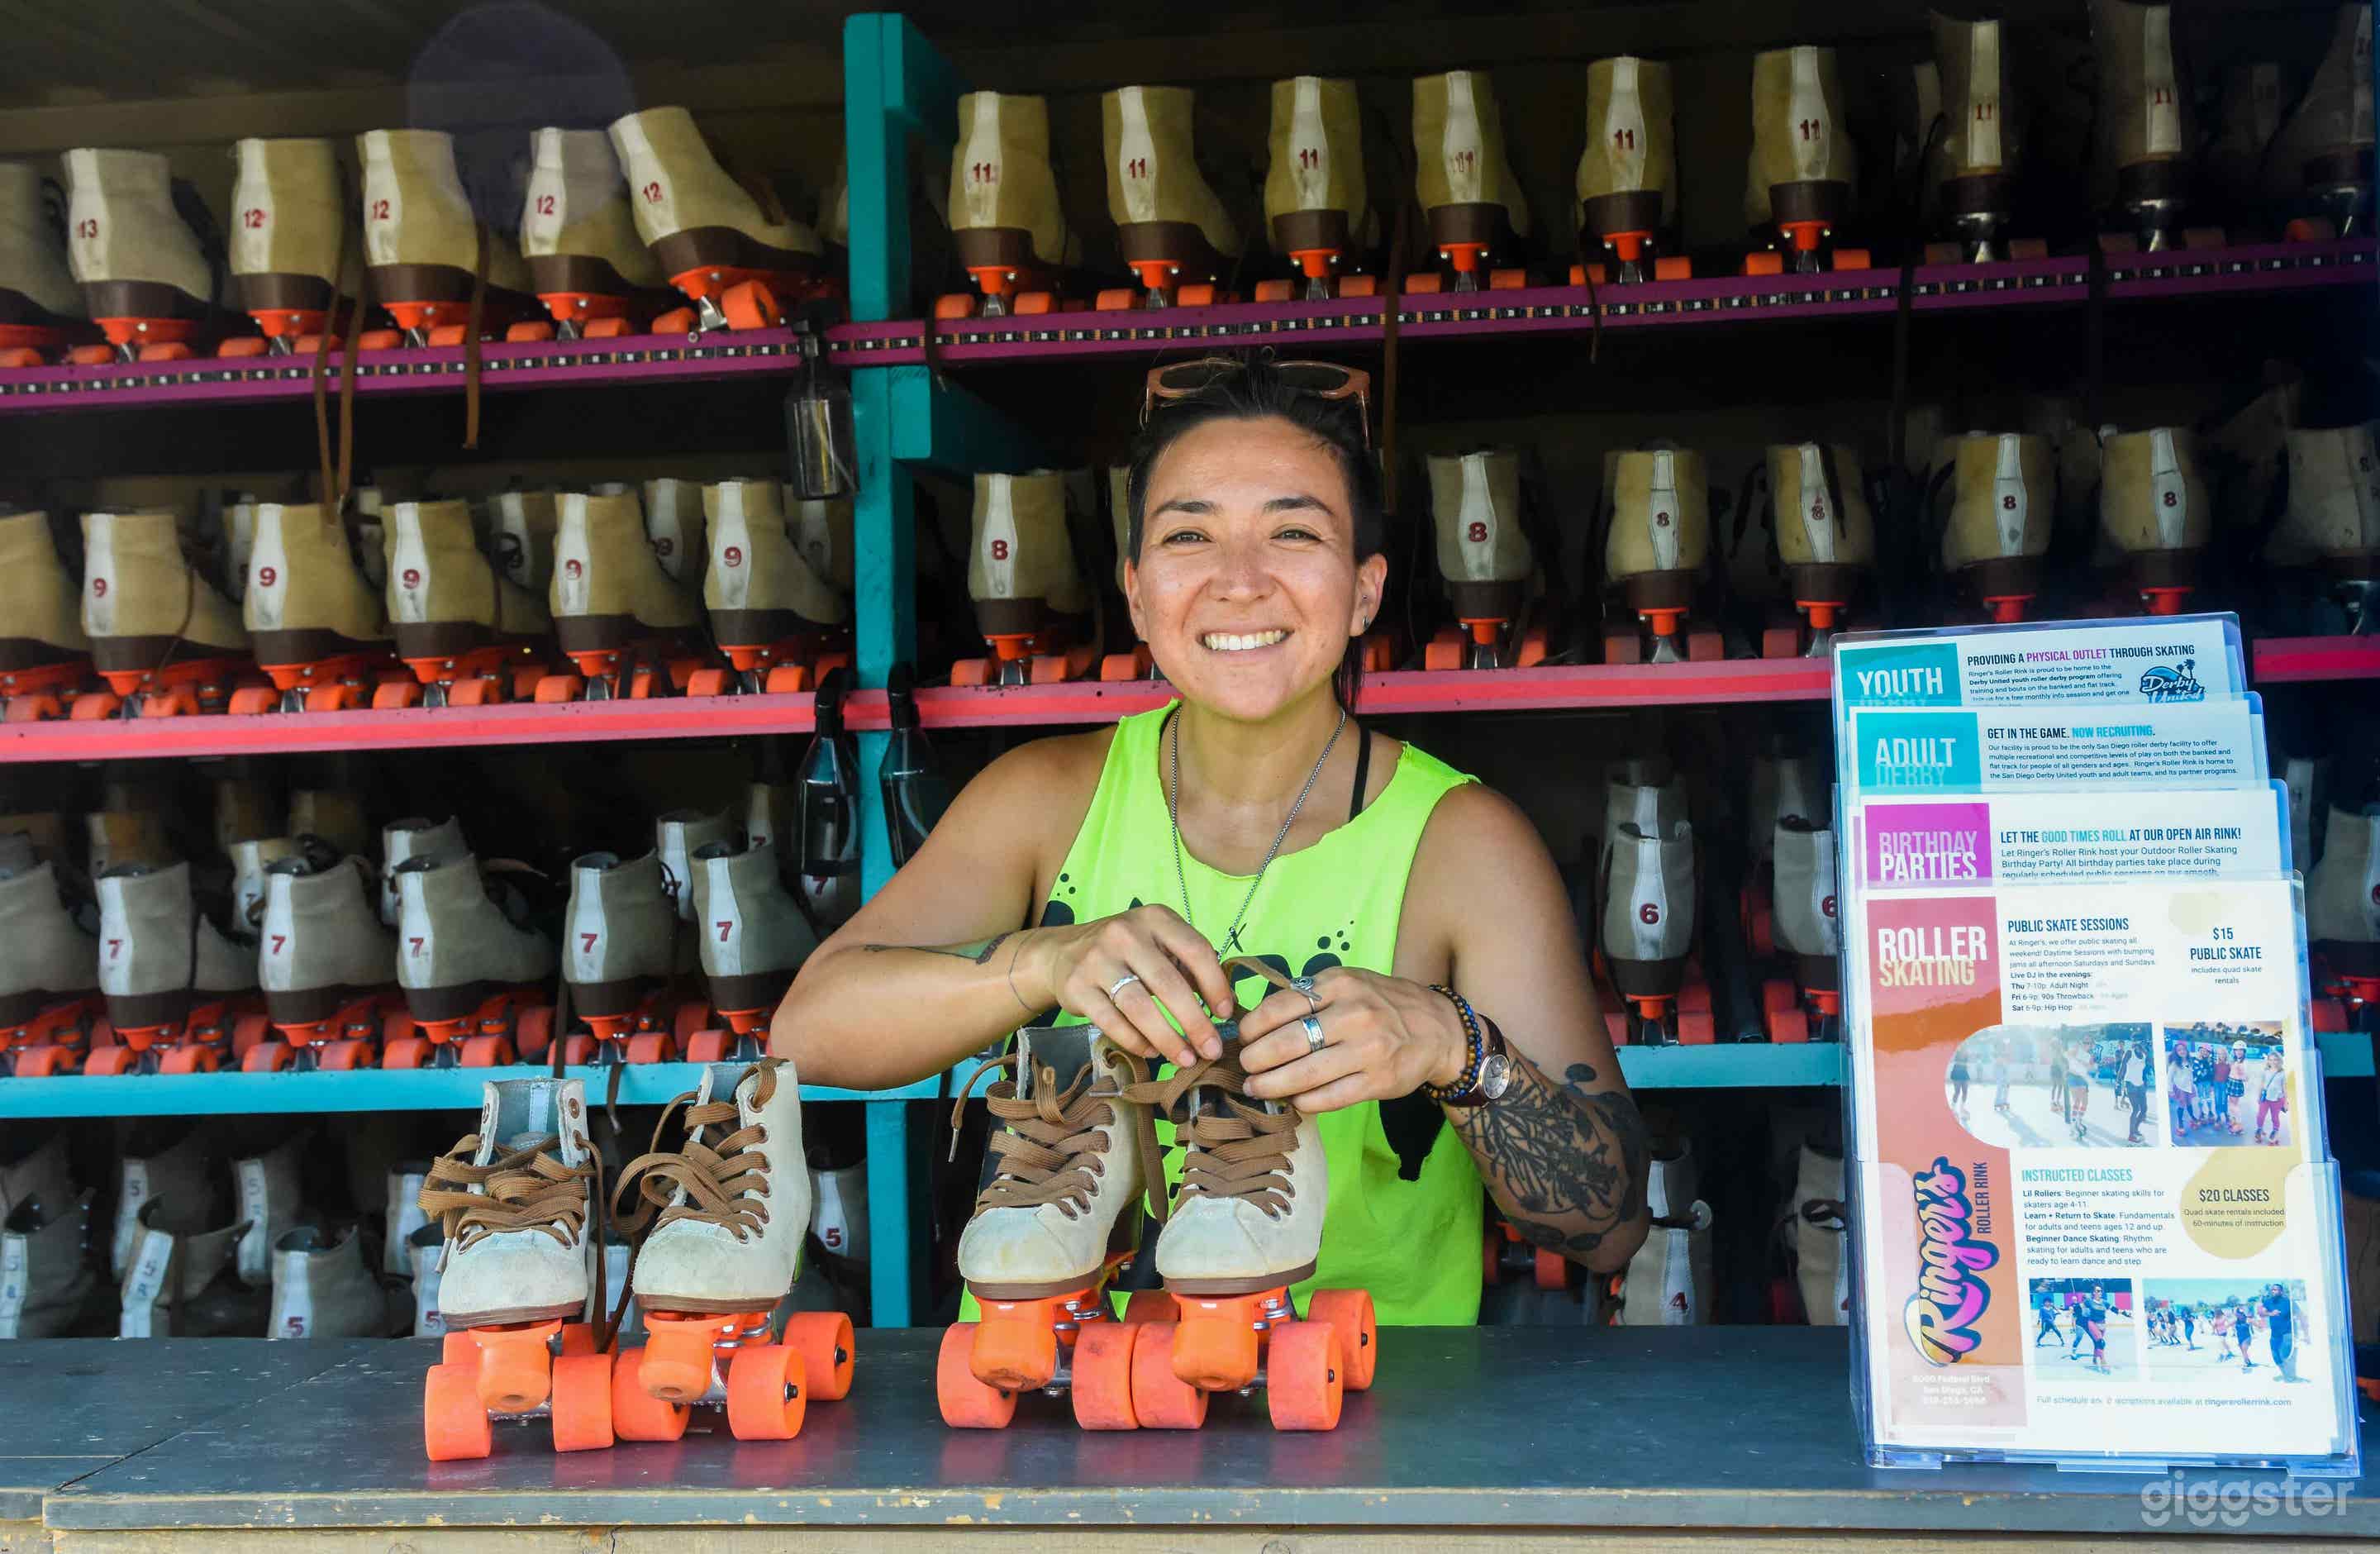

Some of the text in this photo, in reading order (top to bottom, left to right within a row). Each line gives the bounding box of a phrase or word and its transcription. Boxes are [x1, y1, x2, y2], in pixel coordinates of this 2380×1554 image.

[2155, 88, 2172, 105] 11
[1976, 104, 1992, 120] 11
[1800, 119, 1820, 139] 11
[1615, 129, 1634, 150] 11
[1129, 159, 1146, 179] 11
[1300, 149, 1318, 169] 11
[1455, 151, 1473, 172] 11
[973, 163, 991, 183] 11
[642, 181, 662, 203] 12
[373, 199, 389, 220] 12
[536, 195, 555, 215] 12
[79, 219, 98, 238] 13
[244, 209, 264, 228] 12
[2003, 495, 2016, 510] 8
[2163, 491, 2177, 507] 8
[1657, 512, 1670, 527] 8
[1468, 522, 1488, 542] 8
[725, 546, 741, 567] 9
[991, 540, 1008, 560] 8
[259, 567, 276, 586] 9
[402, 569, 420, 589] 9
[566, 559, 582, 579] 9
[93, 578, 107, 597] 9
[1968, 645, 2195, 666] PROVIDING A PHYSICAL OUTLET THROUGH SKATING
[1857, 667, 1944, 697] YOUTH
[2012, 676, 2030, 684] youth
[2049, 675, 2067, 683] derby
[2068, 674, 2096, 682] program
[2141, 675, 2196, 692] Derby
[1987, 725, 2155, 739] GET IN THE GAME. NOW RECRUITING.
[1875, 737, 1957, 768] ADULT
[2016, 772, 2035, 780] Diego
[2078, 771, 2097, 779] youth
[1878, 831, 1978, 855] BIRTHDAY
[2001, 827, 2241, 843] LET THE GOOD TIMES ROLL AT OUR OPEN AIR RINK!
[2002, 849, 2015, 857] Let
[2017, 849, 2049, 858] Ringer's
[2079, 848, 2097, 856] Rink
[2121, 848, 2138, 856] your
[2141, 846, 2176, 855] Outdoor
[2205, 846, 2237, 856] Skating
[1880, 851, 1978, 881] PARTIES
[2002, 860, 2037, 869] Birthday
[2039, 860, 2063, 869] Party!
[2078, 859, 2113, 868] birthday
[2116, 859, 2145, 868] parties
[2168, 857, 2191, 867] place
[2193, 857, 2221, 867] during
[813, 875, 827, 895] 7
[1640, 903, 1659, 924] 6
[716, 921, 732, 941] 7
[2008, 918, 2129, 932] PUBLIC SKATE SESSIONS
[2213, 927, 2234, 941] $15
[107, 939, 122, 959] 7
[271, 935, 286, 955] 7
[409, 937, 424, 957] 7
[581, 933, 597, 953] 7
[1878, 926, 1987, 962] ROLLER
[2190, 946, 2262, 960] PUBLIC SKATE
[1878, 959, 1976, 987] SKATING
[2223, 966, 2240, 975] quad
[2022, 1169, 2134, 1182] INSTRUCTED CLASSES
[1973, 1162, 1992, 1234] ROLLER RINK
[2065, 1190, 2099, 1199] Beginner
[2102, 1190, 2130, 1199] skating
[2199, 1189, 2270, 1203] $20 CLASSES
[826, 1228, 841, 1247] 5
[2026, 1235, 2060, 1244] Beginner
[2123, 1235, 2153, 1244] Rhythm
[1906, 1156, 1999, 1366] Ringer's
[2027, 1258, 2049, 1266] ready
[2124, 1258, 2141, 1266] step
[1670, 1292, 1688, 1312] 4
[288, 1316, 304, 1336] 5
[426, 1311, 440, 1329] 5
